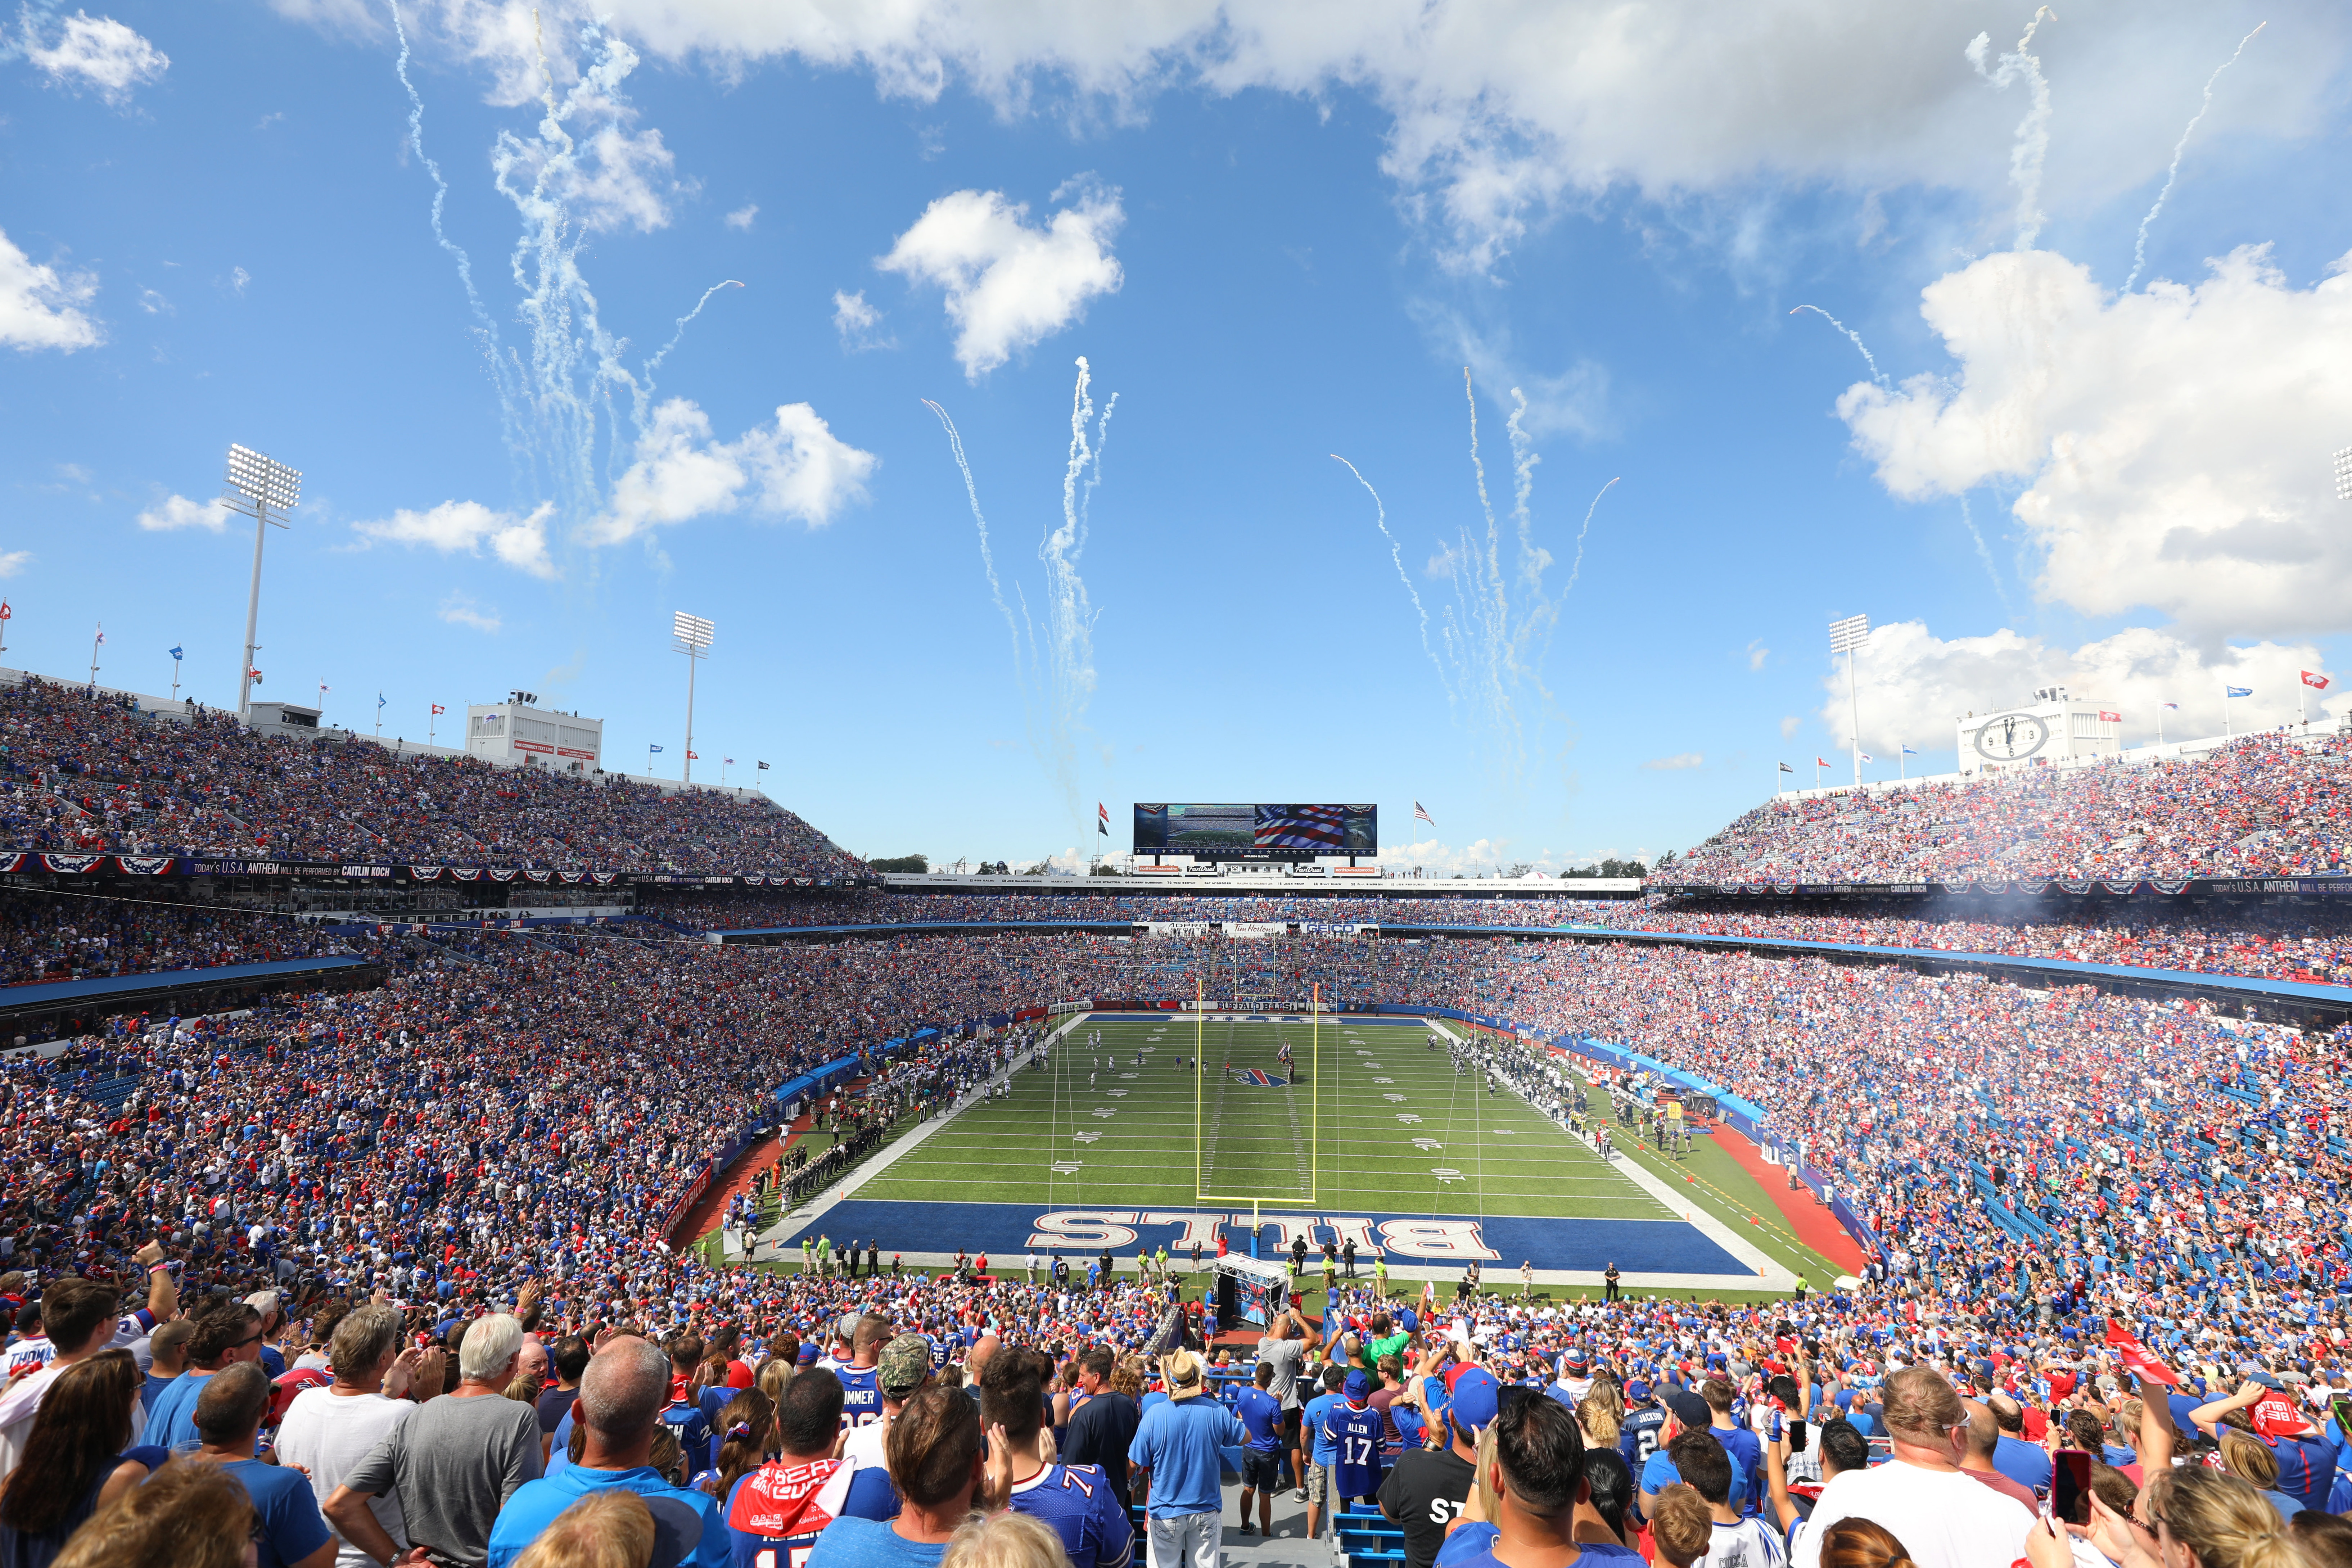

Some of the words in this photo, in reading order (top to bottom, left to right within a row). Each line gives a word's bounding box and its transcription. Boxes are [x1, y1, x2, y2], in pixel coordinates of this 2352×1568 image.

[2030, 731, 2034, 739] 3
[1988, 737, 1993, 746] 9
[2009, 748, 2014, 756] 6
[195, 861, 220, 873] TODAY'S
[222, 862, 245, 873] U.S.A.
[247, 862, 279, 874] ANTHEM
[303, 867, 332, 876] PERFORMED
[342, 866, 370, 876] CAITLIN
[371, 867, 390, 877] KOCH
[2212, 882, 2236, 892] TODAY'S
[2237, 881, 2262, 892] U.S.A.
[2264, 881, 2299, 893] ANTHEM
[2301, 884, 2316, 892] WILL
[2318, 884, 2327, 892] BE
[381, 925, 393, 934] 132
[511, 920, 520, 928] 134
[1248, 924, 1273, 932] Hortons
[1307, 924, 1354, 933] GEICO
[1168, 1015, 1342, 1024] BILLS
[1092, 1108, 1117, 1116] 30
[1396, 1114, 1422, 1122] 30
[1074, 1131, 1102, 1141] 20
[1411, 1138, 1443, 1149] 20
[1051, 1160, 1083, 1172] 10
[1431, 1168, 1466, 1181] 10
[689, 1176, 706, 1207] BILLS
[663, 1199, 687, 1239] UFFALO
[1024, 1211, 1502, 1261] BILLS
[9, 1346, 57, 1369] THOMAS
[844, 1390, 874, 1405] IMMER
[1638, 1412, 1664, 1423] JACKSON
[1347, 1423, 1368, 1434] ALLEN
[1638, 1429, 1663, 1461] 2
[1344, 1437, 1372, 1466] 17
[775, 1459, 830, 1485] BEA
[1062, 1464, 1097, 1498] 70
[799, 1516, 818, 1525] Kaleida
[1718, 1554, 1748, 1568] CIOCCA
